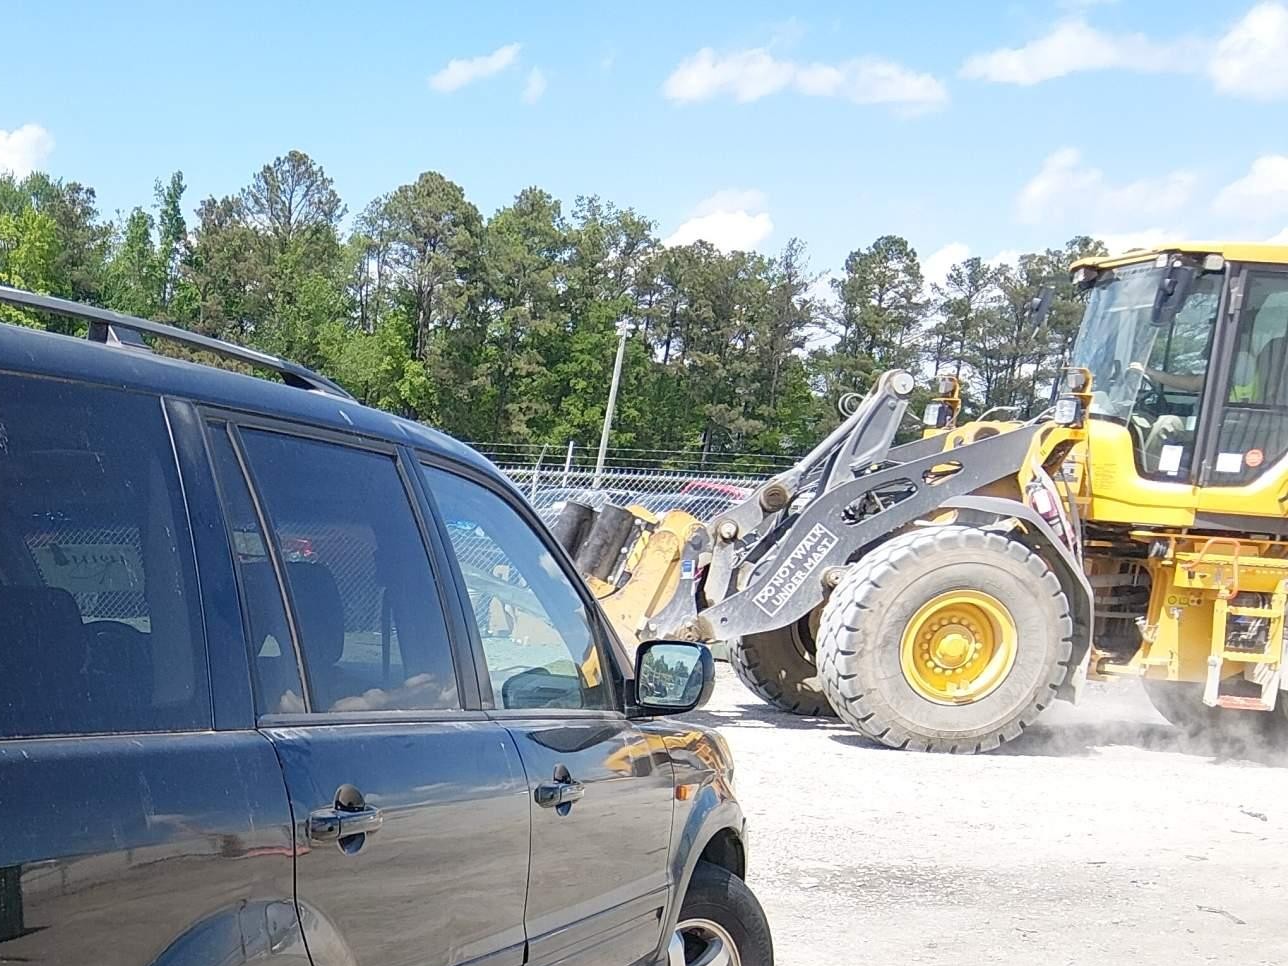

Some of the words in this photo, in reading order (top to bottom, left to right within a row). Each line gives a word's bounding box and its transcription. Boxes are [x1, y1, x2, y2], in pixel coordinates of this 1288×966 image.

[757, 586, 775, 603] DO
[773, 557, 795, 586] NOT
[792, 527, 825, 559] WALK
[772, 570, 806, 606] UNDER
[803, 538, 831, 570] MAST
